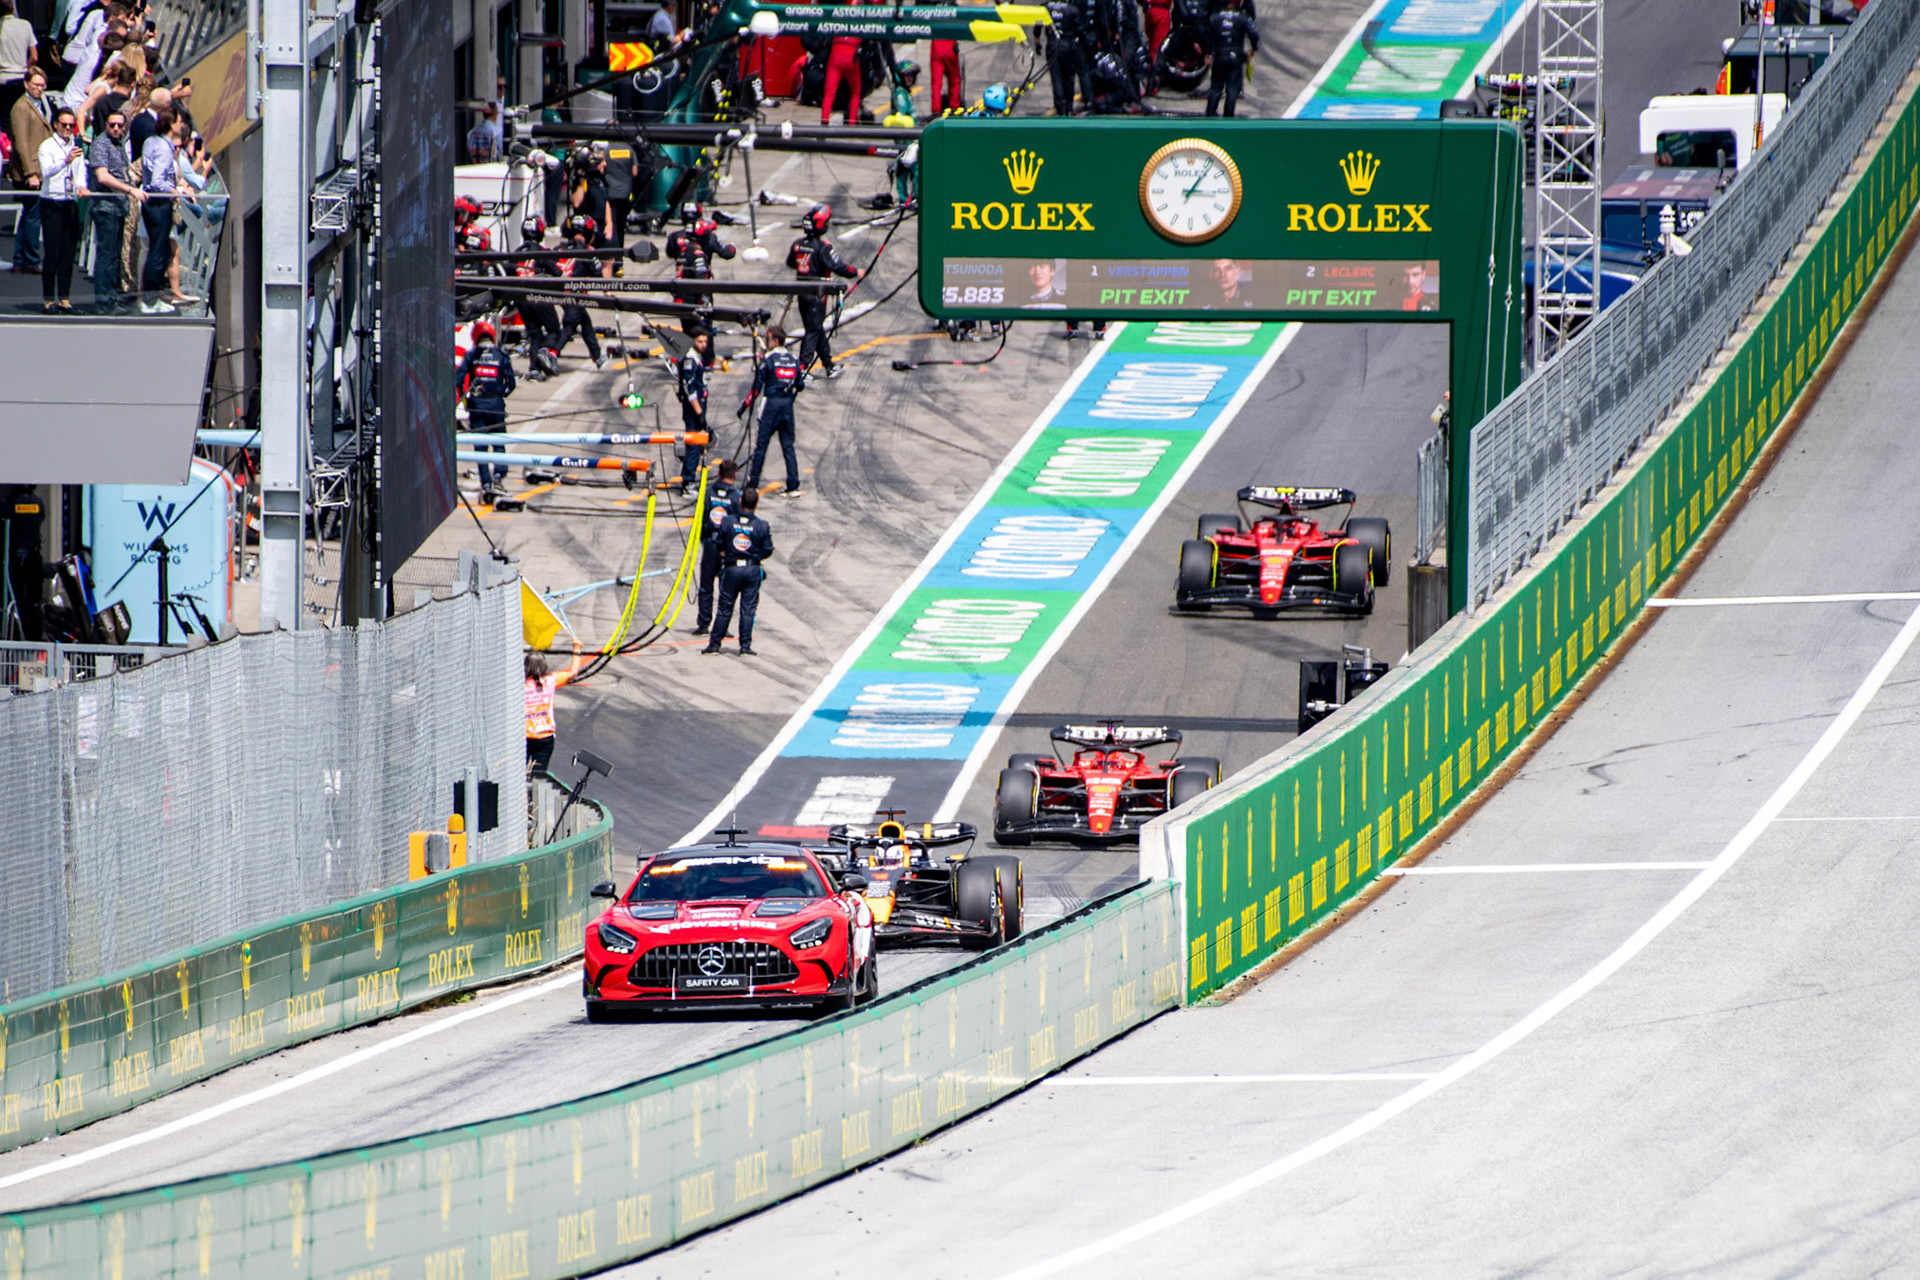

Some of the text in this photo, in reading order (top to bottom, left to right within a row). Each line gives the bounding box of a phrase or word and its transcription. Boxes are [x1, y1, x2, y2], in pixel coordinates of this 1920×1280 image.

[785, 7, 824, 16] aramco
[832, 8, 864, 17] ASTON
[912, 8, 957, 19] cognizant
[817, 22, 848, 32] ASTON
[850, 24, 886, 33] MARTIN
[893, 25, 932, 34] aramco
[1174, 169, 1207, 177] ROLE
[951, 203, 1094, 231] ROLEX
[1287, 204, 1431, 232] ROLEX
[945, 264, 1004, 275] TSUNODA
[1091, 265, 1190, 277] 1 VERSTAPPEN
[1307, 266, 1376, 277] 2 LECLERC
[942, 286, 1005, 304] 5.883
[1100, 289, 1190, 305] PIT EXIT
[1286, 290, 1376, 305] PIT EXIT
[611, 433, 642, 444] Gulf
[562, 457, 589, 468] Gulf
[123, 542, 189, 553] WILMS
[22, 666, 43, 676] TOR
[505, 928, 543, 968] ROLEX
[428, 944, 475, 988] ROLEX
[357, 967, 400, 1012] ROLEX
[686, 978, 740, 988] SAFETY CAR
[286, 991, 326, 1035] ROLEX
[229, 1008, 265, 1056] ROLEX
[169, 1029, 206, 1077] ROLEX
[113, 1050, 151, 1098] ROLEX
[43, 1073, 84, 1122] ROLEX
